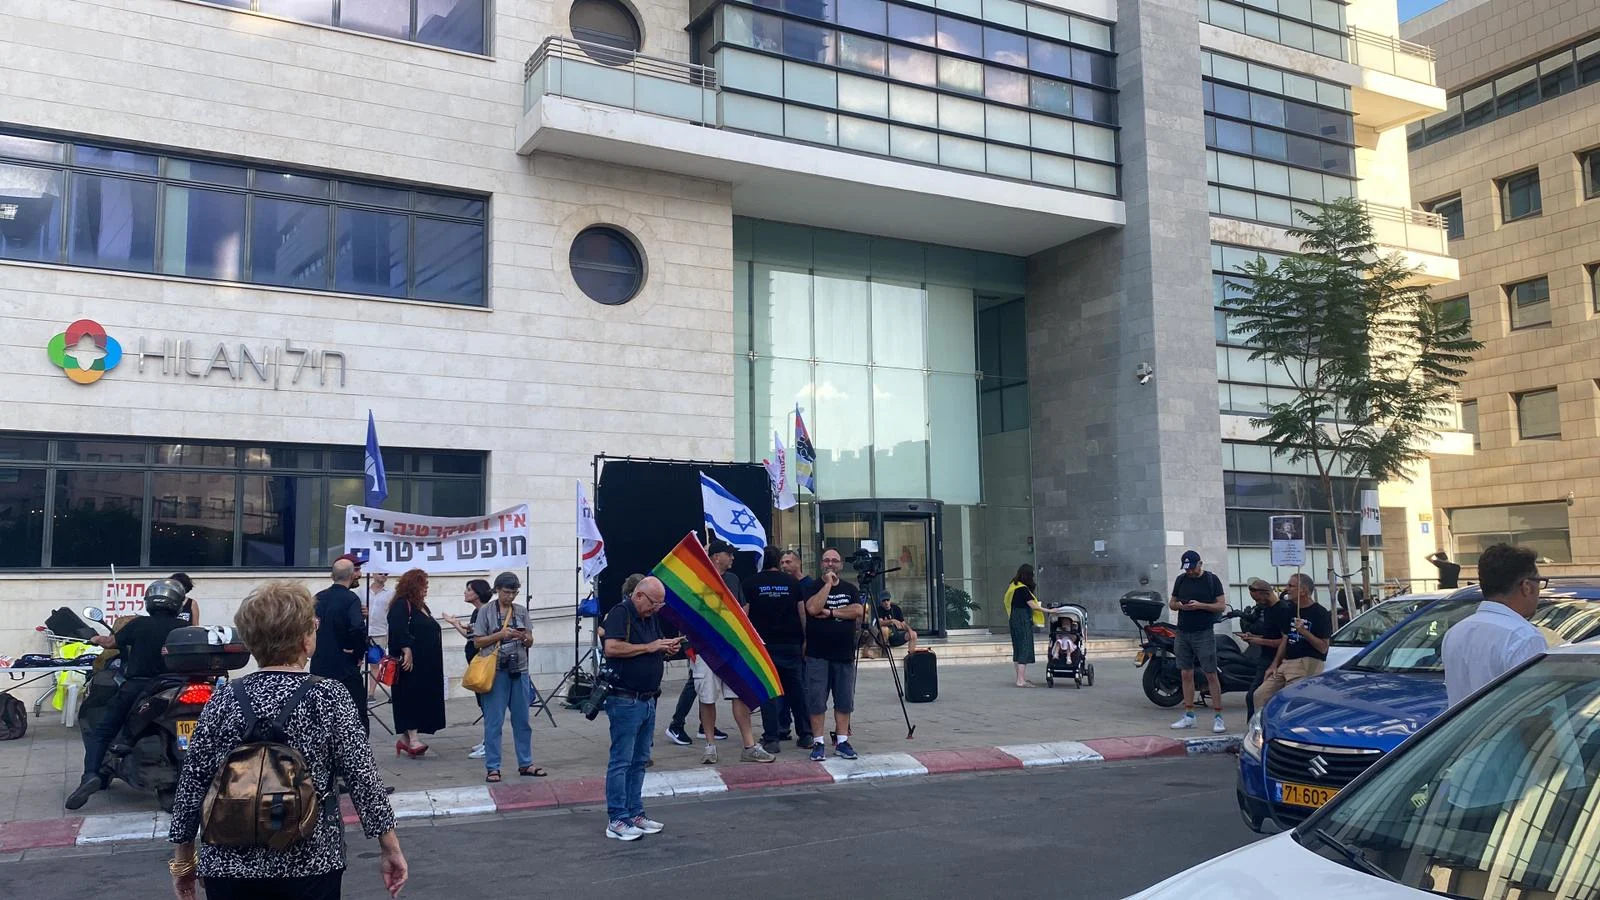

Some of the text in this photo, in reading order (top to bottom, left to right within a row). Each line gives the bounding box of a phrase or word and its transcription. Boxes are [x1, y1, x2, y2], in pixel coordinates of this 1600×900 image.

[138, 336, 269, 382] HILAN
[274, 338, 345, 391] חילן
[352, 513, 385, 533] בלי
[498, 513, 526, 532] אין
[373, 535, 527, 562] חופש ביטוי
[106, 583, 145, 597] חניה
[105, 599, 144, 611] לרכב
